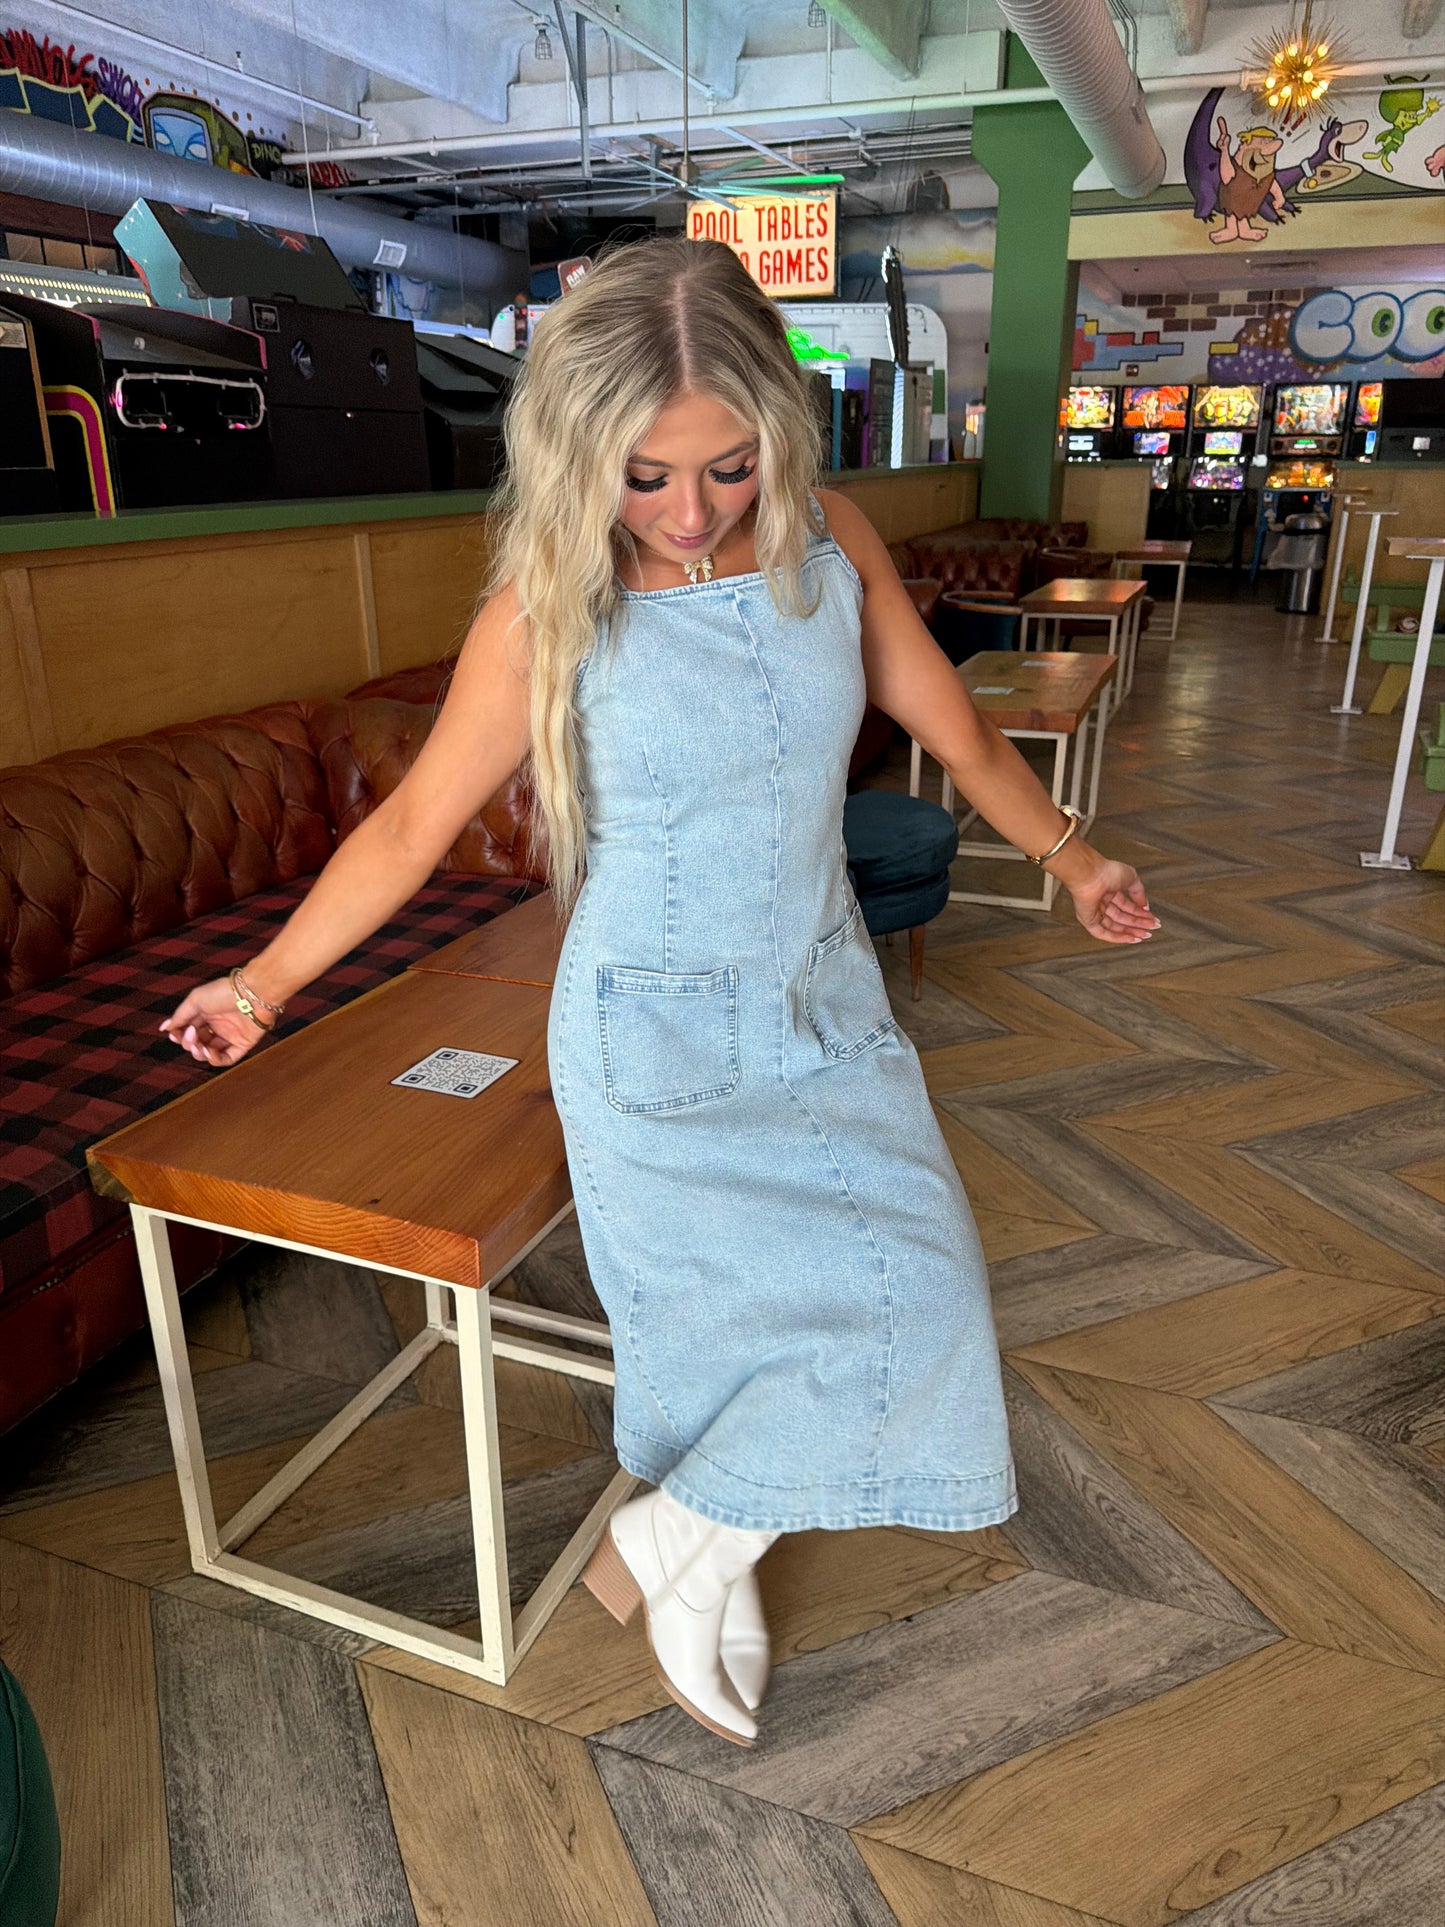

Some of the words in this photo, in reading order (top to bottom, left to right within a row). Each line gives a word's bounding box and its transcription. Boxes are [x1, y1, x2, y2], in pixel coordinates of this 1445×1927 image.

[693, 209, 743, 244] POOL
[755, 202, 828, 242] TABLES
[566, 264, 586, 289] RAW
[759, 246, 828, 285] GAMES
